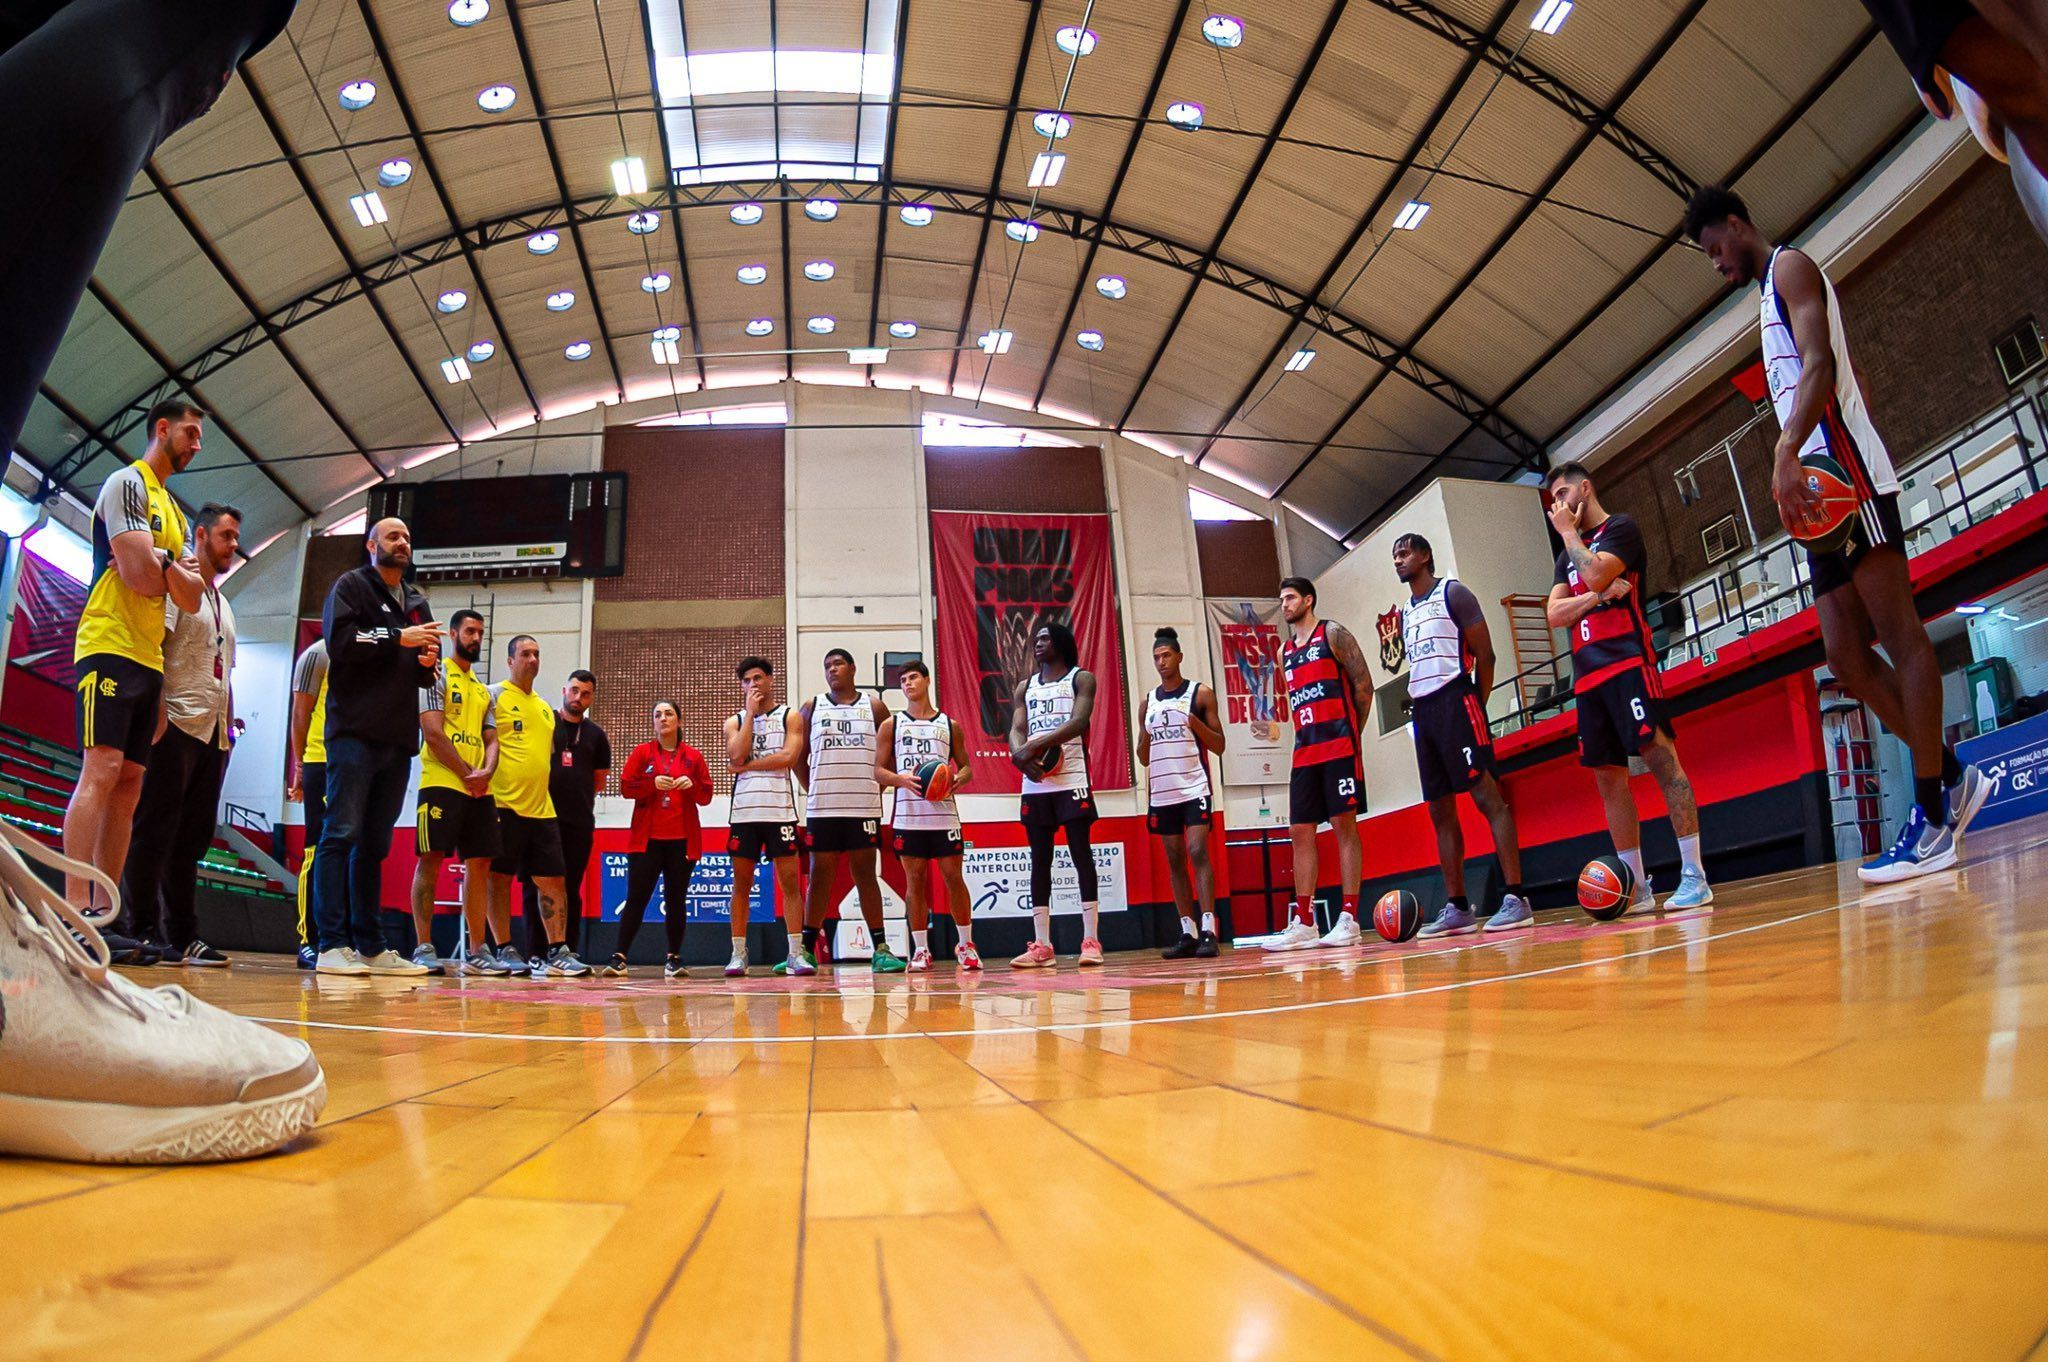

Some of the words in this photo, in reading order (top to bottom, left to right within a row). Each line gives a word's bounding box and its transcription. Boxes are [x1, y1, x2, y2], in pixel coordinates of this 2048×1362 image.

[472, 550, 502, 559] Esporte
[516, 546, 556, 557] BRASIL
[1580, 619, 1590, 642] 6
[1040, 700, 1053, 714] 30
[1228, 696, 1248, 724] DE
[1630, 698, 1645, 721] 6
[1162, 710, 1169, 726] 3
[1300, 707, 1313, 726] 23
[837, 721, 851, 734] 40
[824, 735, 865, 750] pixbet
[917, 740, 931, 754] 20
[1338, 778, 1355, 795] 23
[2012, 770, 2034, 790] CBC
[1199, 797, 1206, 810] 3
[780, 826, 795, 841] 92
[863, 820, 876, 835] 40
[709, 884, 721, 893] DE
[1064, 877, 1076, 885] DE
